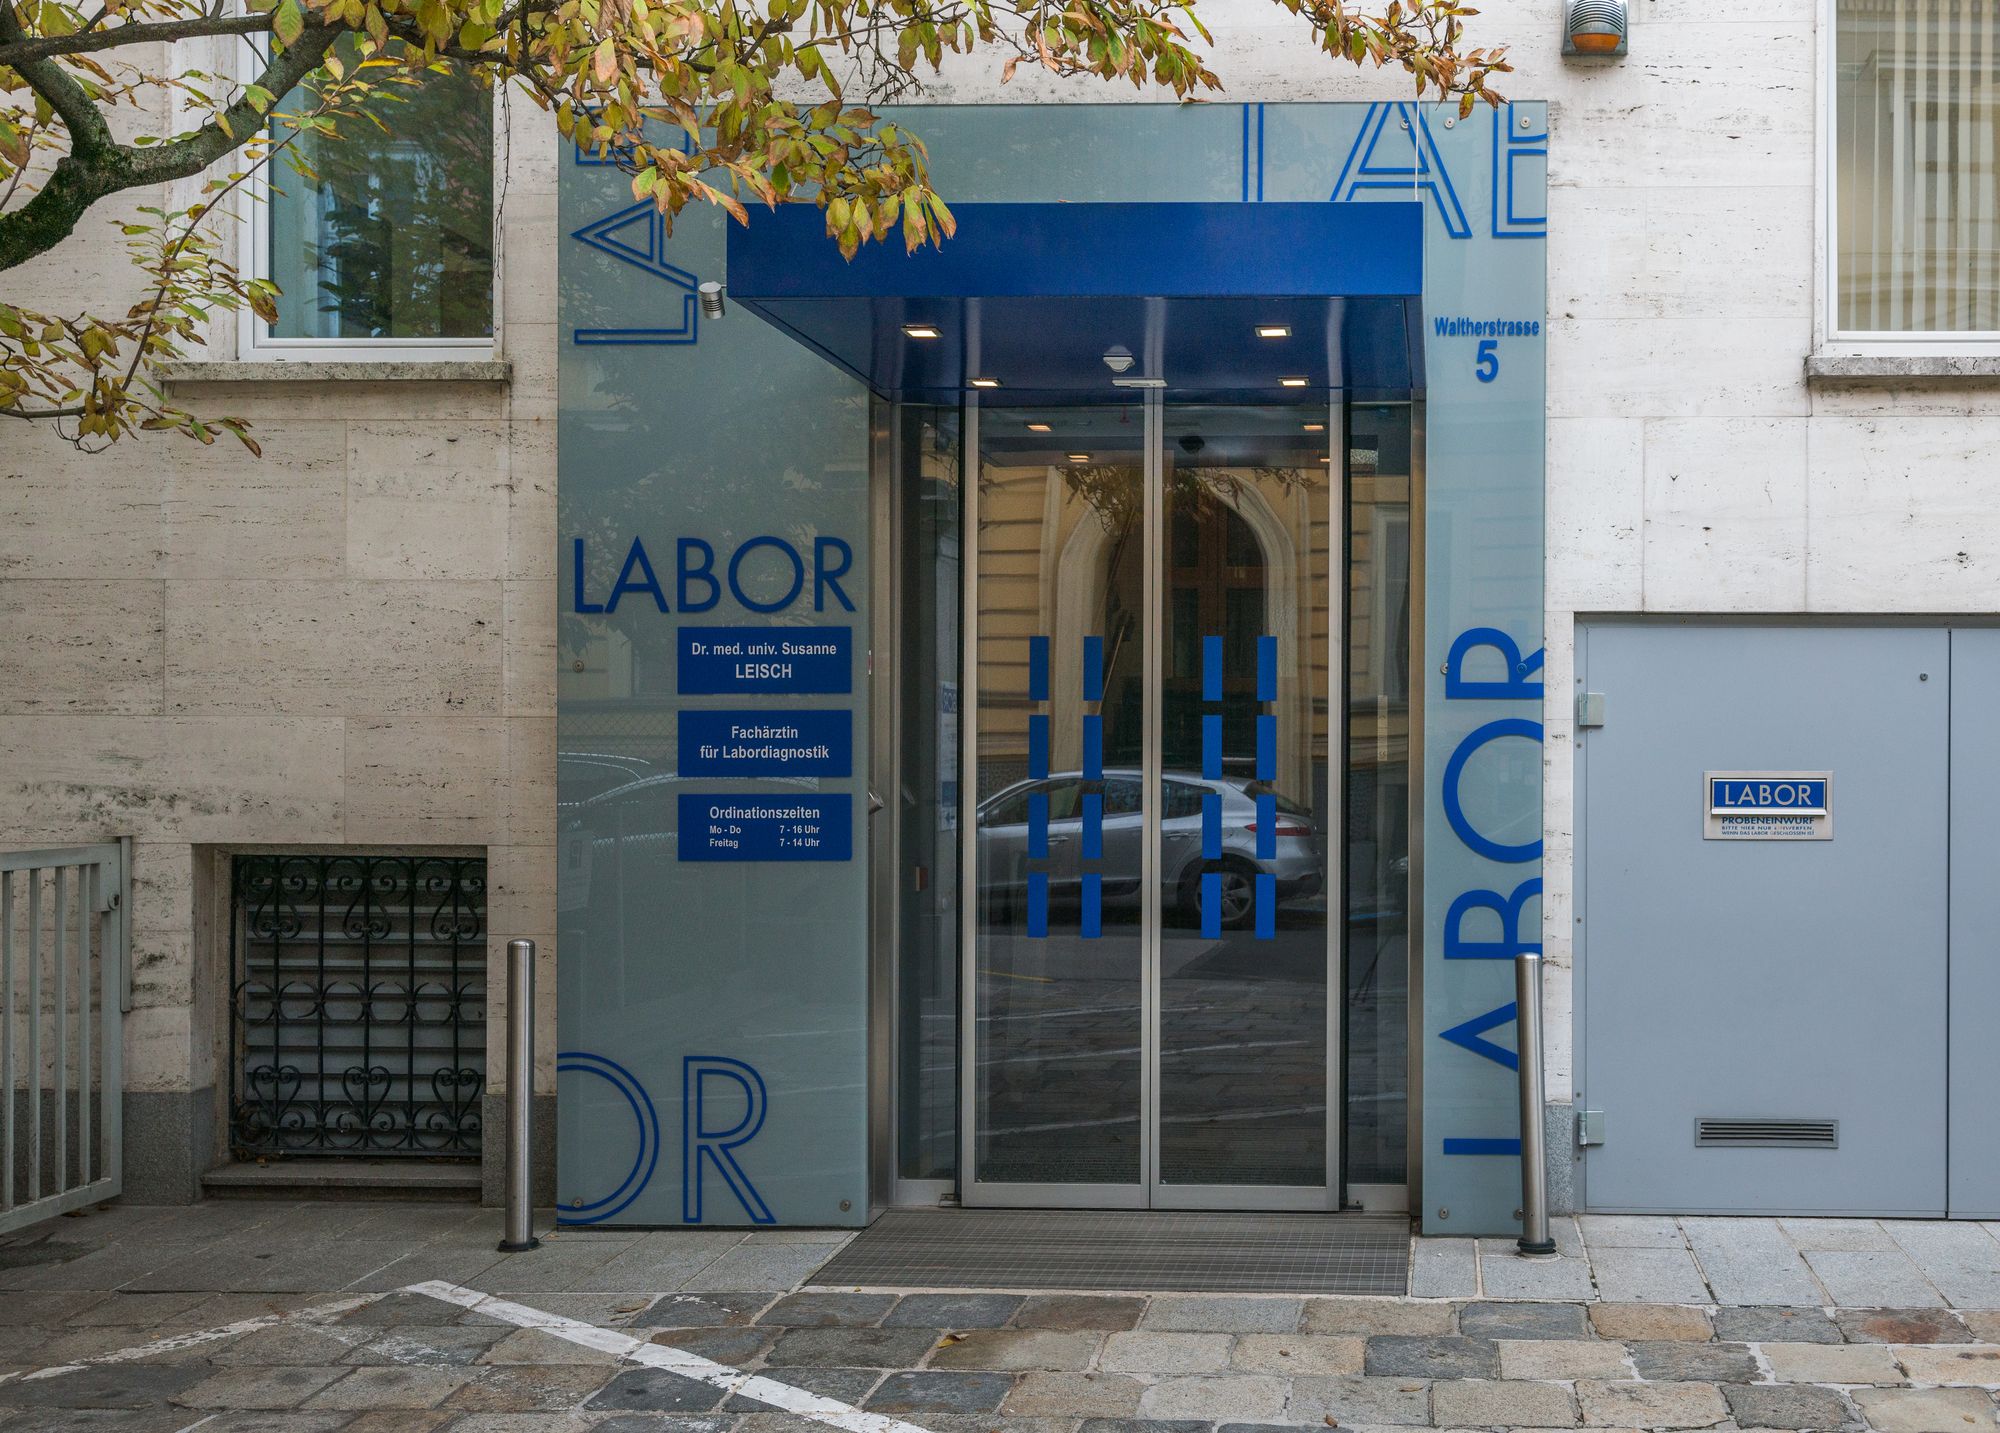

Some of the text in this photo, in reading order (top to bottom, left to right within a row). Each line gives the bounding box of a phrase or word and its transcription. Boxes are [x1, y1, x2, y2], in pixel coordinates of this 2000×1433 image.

[1434, 317, 1540, 337] Waltherstrasse
[1475, 340, 1499, 383] 5
[574, 535, 856, 614] LABOR
[692, 642, 837, 655] Dr. med. univ. Susanne
[735, 663, 792, 679] LEISCH
[731, 726, 798, 739] Fachärztin
[700, 745, 830, 762] für Labordiagnostik
[1724, 784, 1812, 806] LABOR
[709, 806, 820, 819] Ordinationszeiten
[1722, 816, 1815, 824] PROBENEINWURF
[709, 825, 722, 834] Mo
[729, 825, 742, 834] Do
[779, 825, 784, 834] 7
[792, 825, 802, 834] 16
[804, 825, 820, 834] Uhr
[709, 838, 739, 849] Freitag
[779, 838, 784, 847] 7
[792, 838, 802, 847] 14
[804, 838, 820, 847] Uhr
